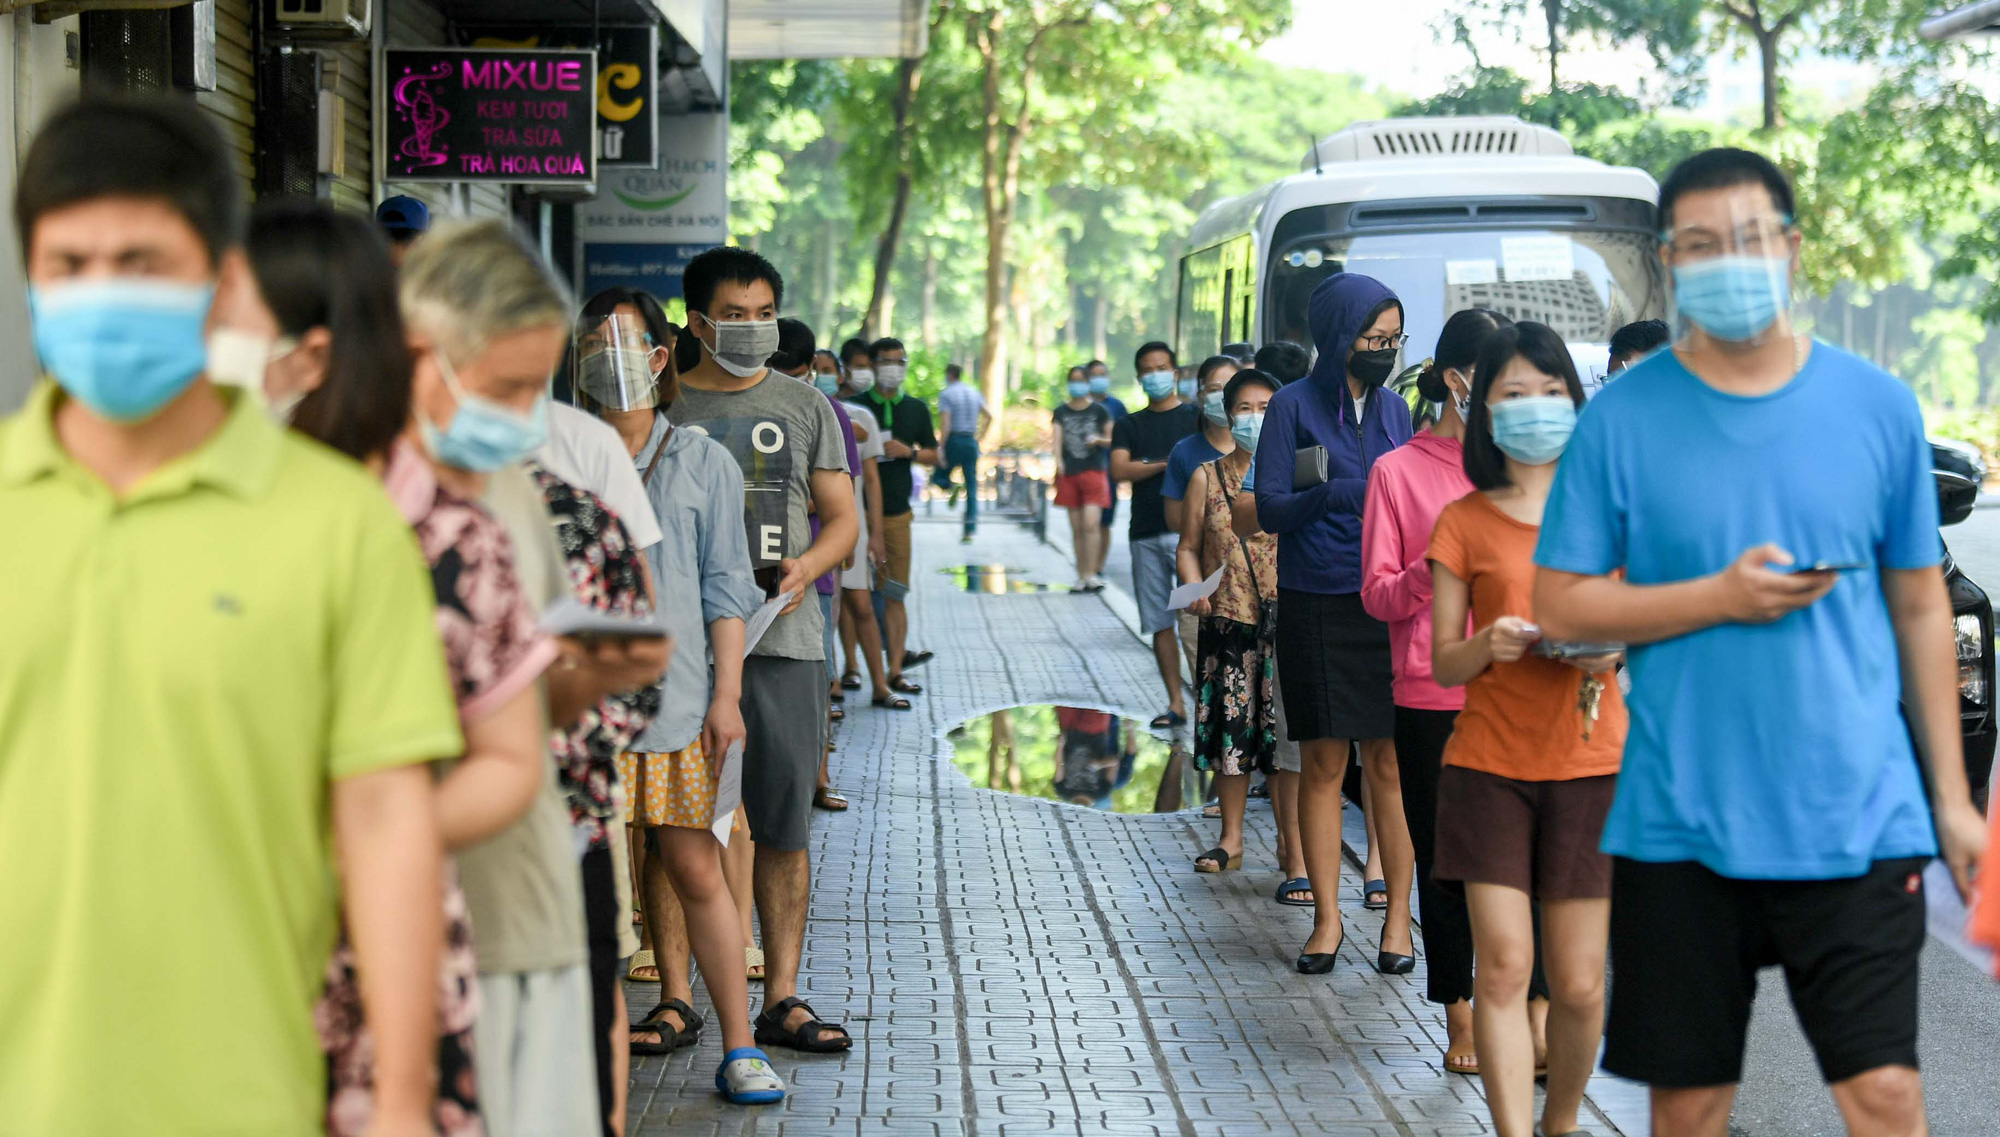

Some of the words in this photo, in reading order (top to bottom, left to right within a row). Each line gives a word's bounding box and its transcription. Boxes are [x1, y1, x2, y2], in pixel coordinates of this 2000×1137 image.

[462, 59, 582, 91] MIXUE
[476, 101, 516, 119] KEM
[524, 101, 568, 120] TƯƠI
[501, 154, 541, 174] HOA
[752, 421, 785, 454] O
[760, 525, 782, 560] E
